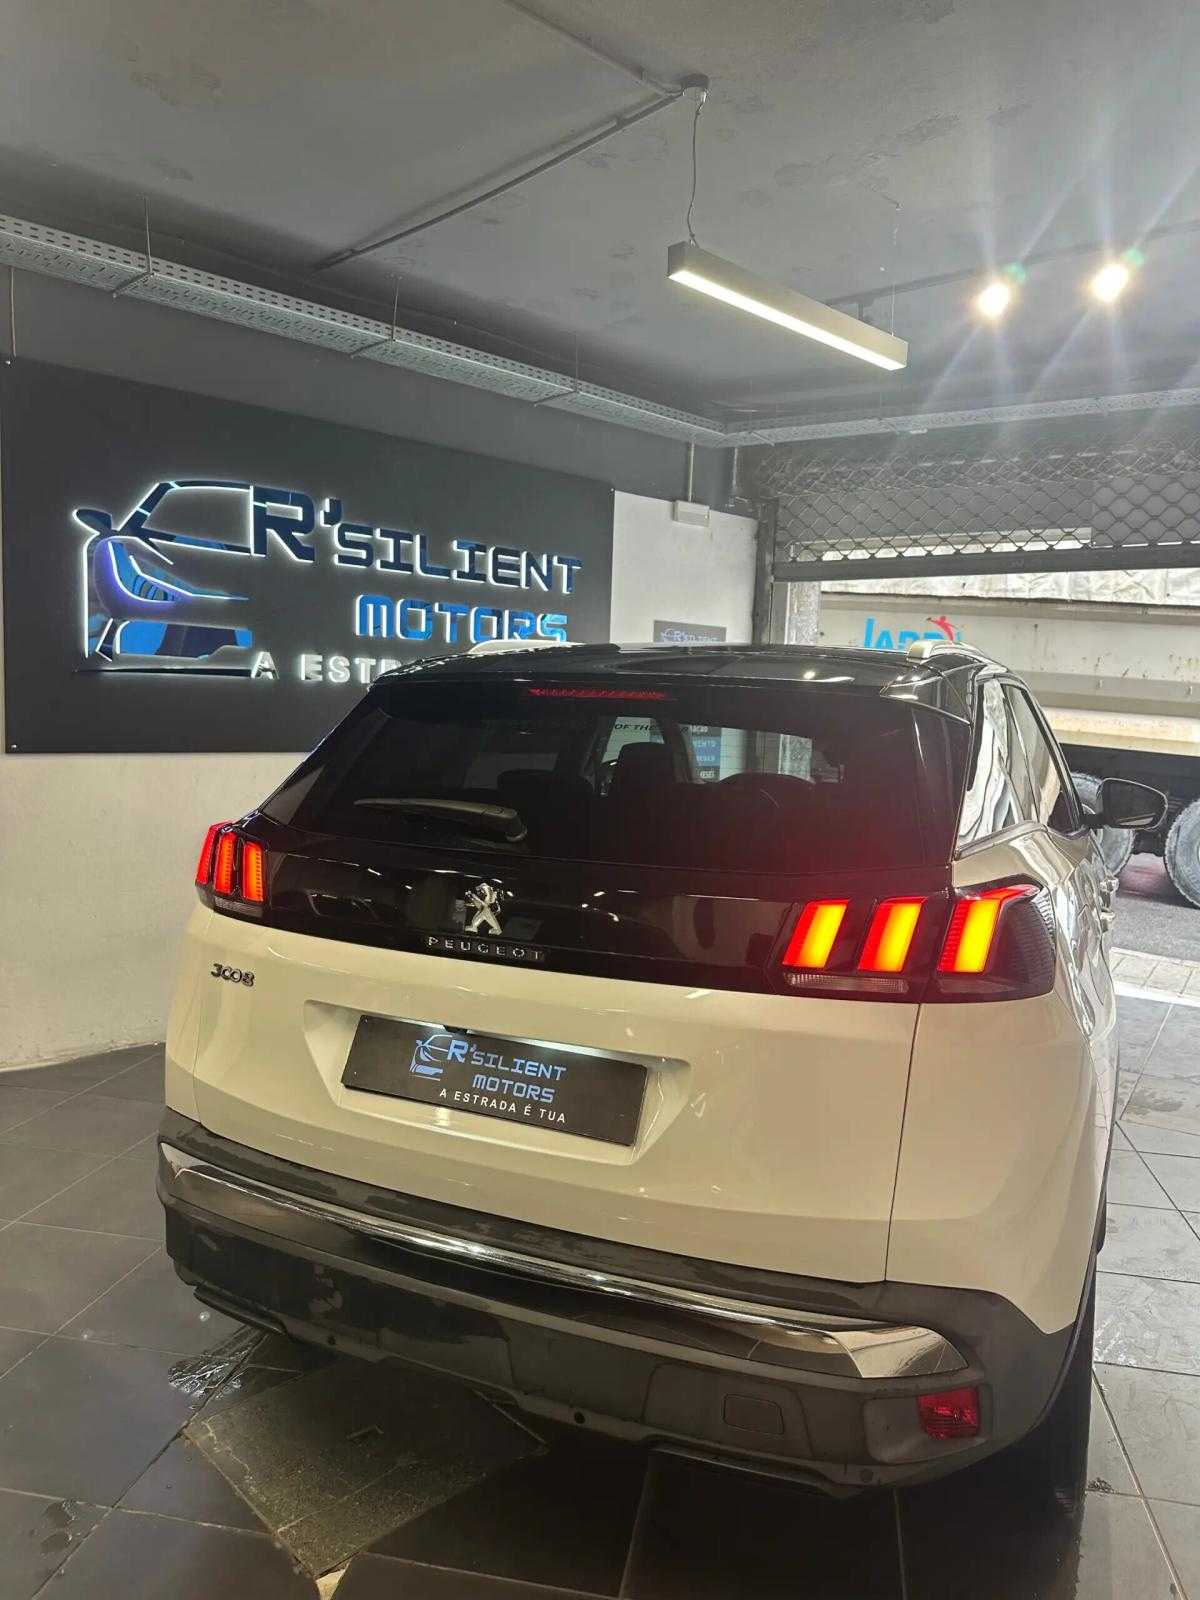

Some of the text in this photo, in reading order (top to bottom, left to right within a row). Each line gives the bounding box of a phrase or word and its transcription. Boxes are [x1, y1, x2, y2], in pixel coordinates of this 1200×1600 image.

[355, 594, 568, 644] MOTORS
[250, 650, 280, 681] A
[428, 936, 543, 960] PEUGEOT
[211, 963, 255, 987] 3008
[472, 1074, 556, 1104] MOTORS
[440, 1088, 566, 1123] A ESTRADA É TUA
